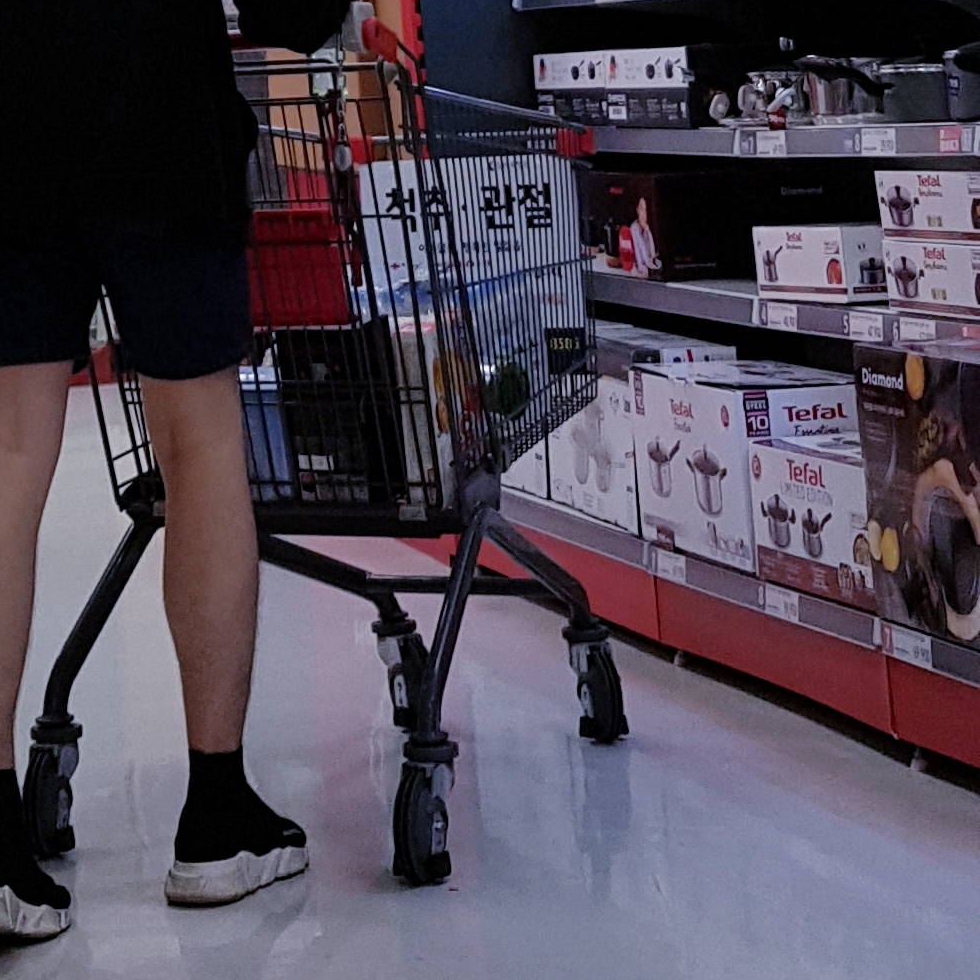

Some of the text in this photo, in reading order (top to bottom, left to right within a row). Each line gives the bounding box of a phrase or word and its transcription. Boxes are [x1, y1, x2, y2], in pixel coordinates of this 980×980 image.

[917, 174, 942, 187] Tefal
[922, 246, 947, 261] Tefal
[861, 367, 904, 390] Diamond
[670, 398, 694, 419] Tefal
[782, 402, 848, 423] Tefal
[747, 416, 770, 431] 10
[786, 458, 826, 489] Tefal
